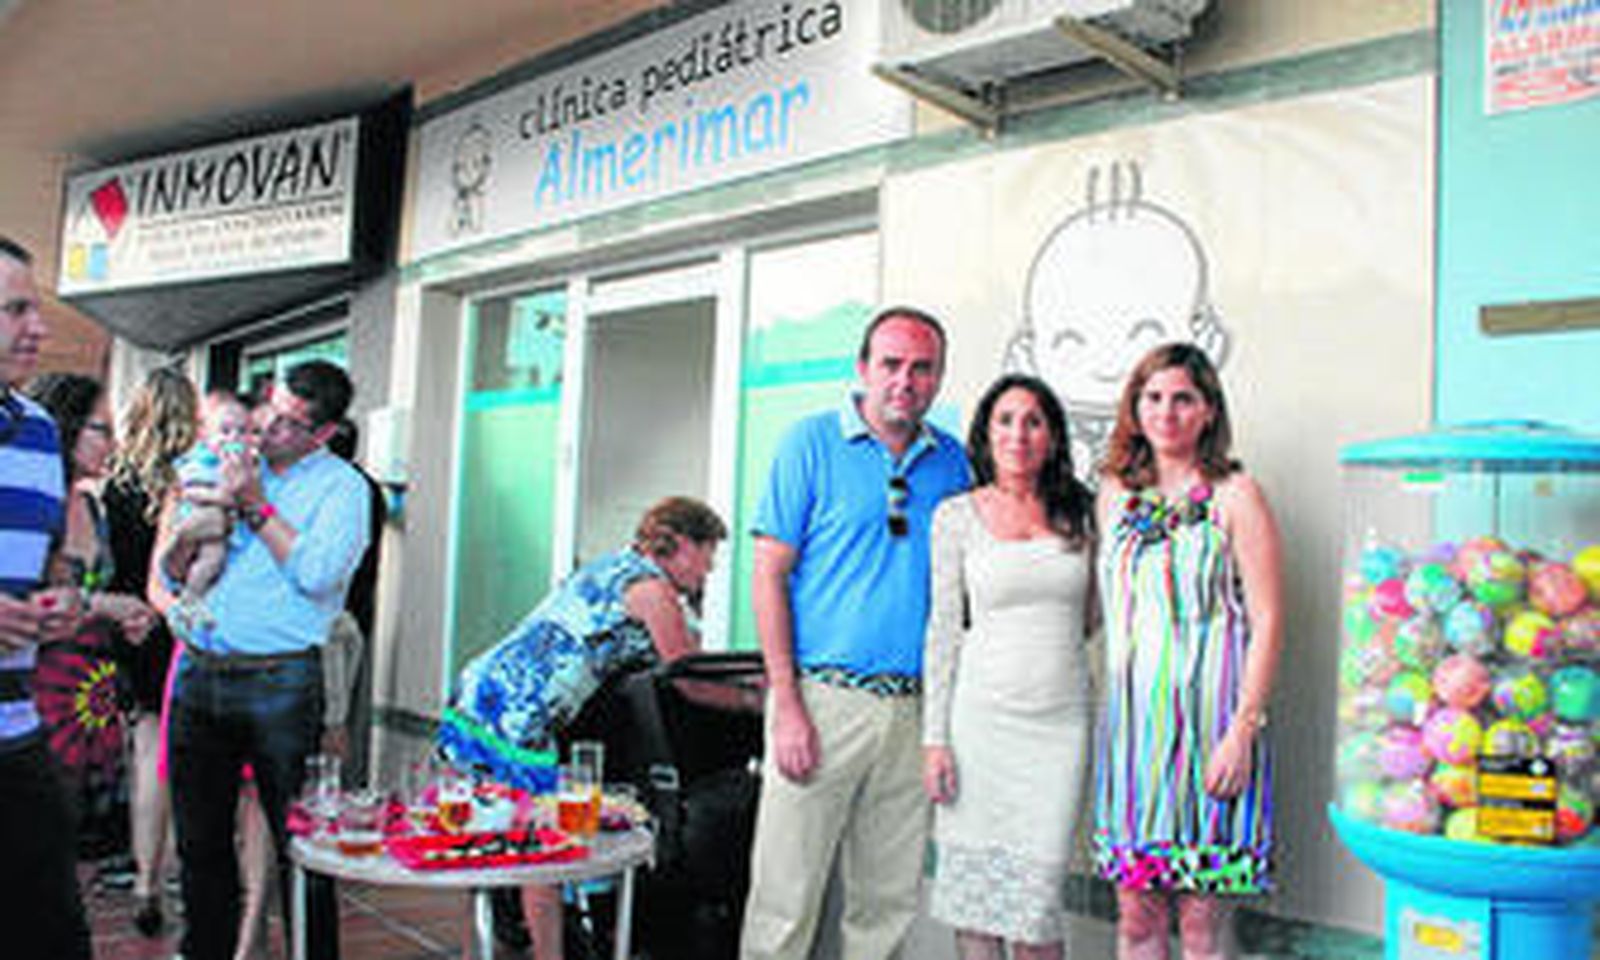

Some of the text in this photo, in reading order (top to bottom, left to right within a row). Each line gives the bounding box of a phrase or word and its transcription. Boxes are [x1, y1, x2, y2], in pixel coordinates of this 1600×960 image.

[518, 0, 844, 141] clínica pediátrica
[136, 132, 342, 216] INMOVAN
[534, 77, 811, 208] Almerimar
